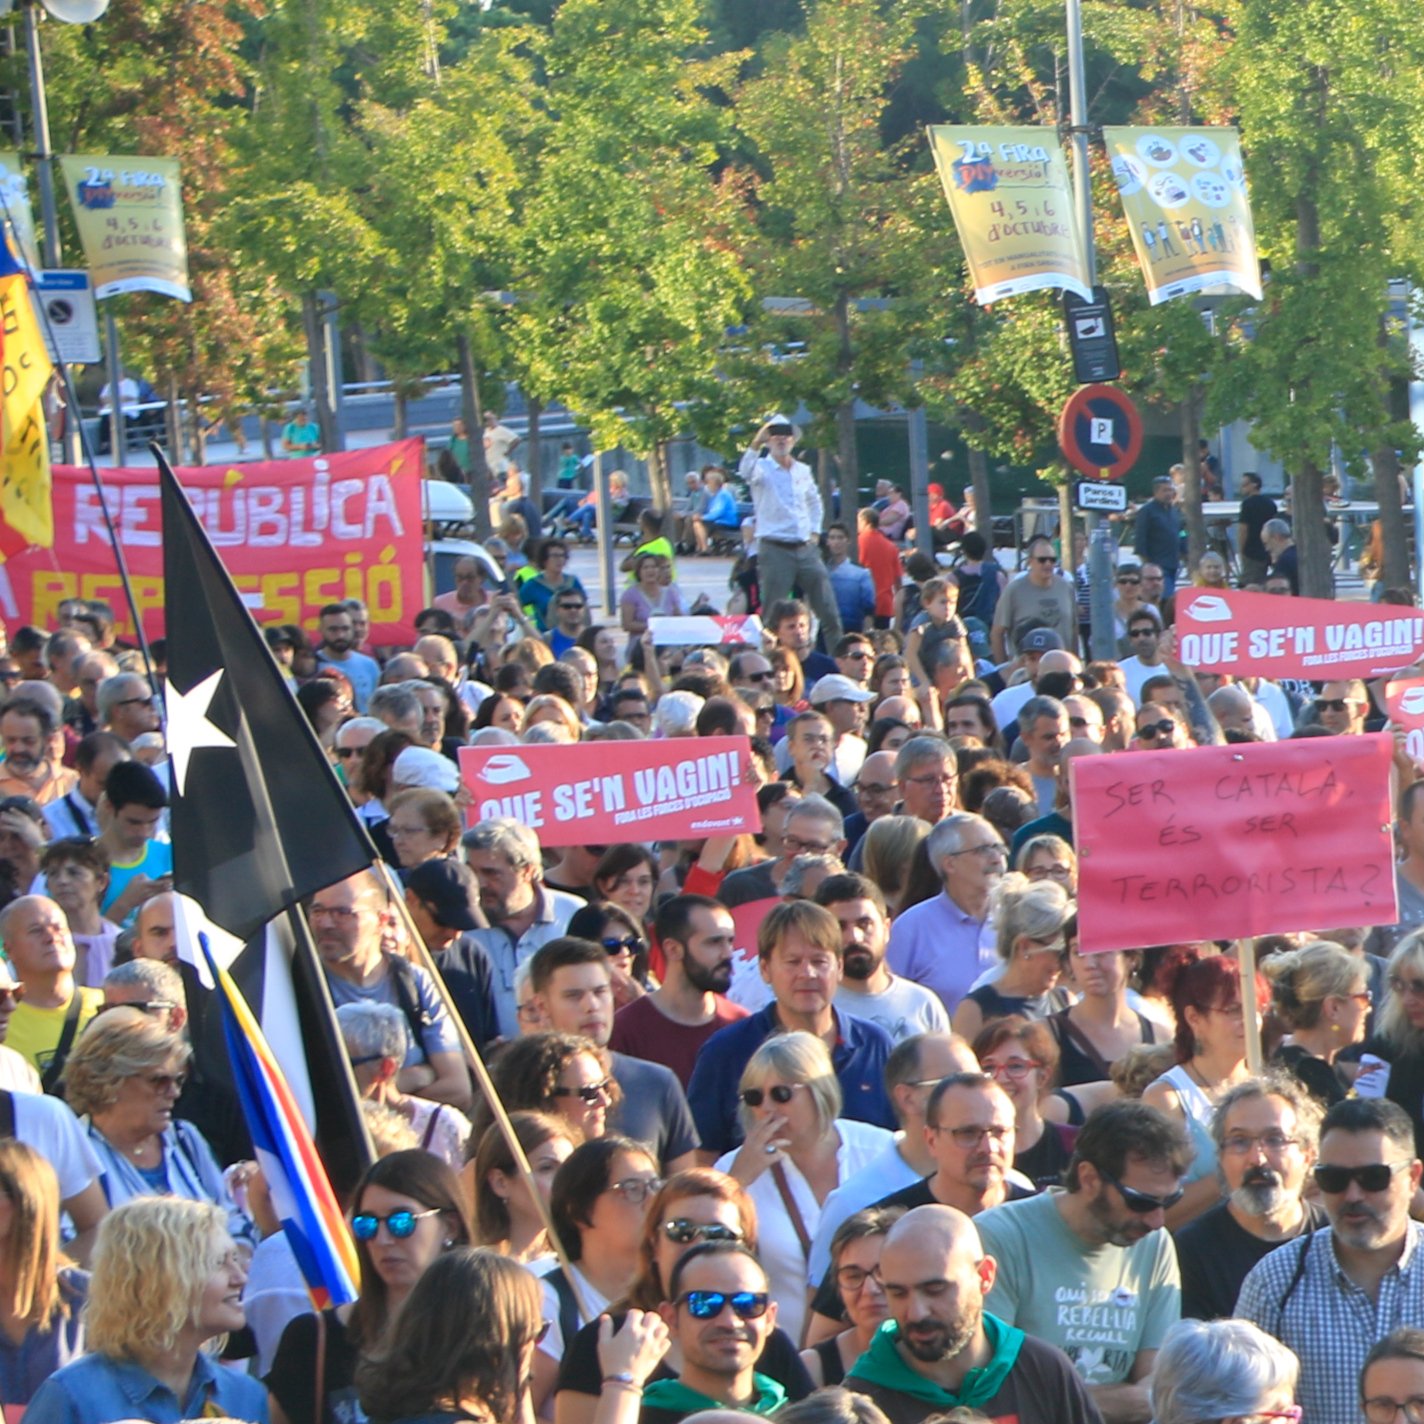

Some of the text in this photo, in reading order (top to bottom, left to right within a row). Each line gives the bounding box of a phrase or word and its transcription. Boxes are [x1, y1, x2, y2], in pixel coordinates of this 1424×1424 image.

[1016, 200, 1027, 215] 5
[1044, 199, 1055, 216] 6
[1099, 422, 1106, 438] P
[1181, 617, 1424, 667] QUE SE'N VAGIN!
[480, 750, 740, 830] QUE SE'N VAGIN!
[1104, 779, 1176, 819] SER
[1158, 812, 1298, 847] ÉS SER
